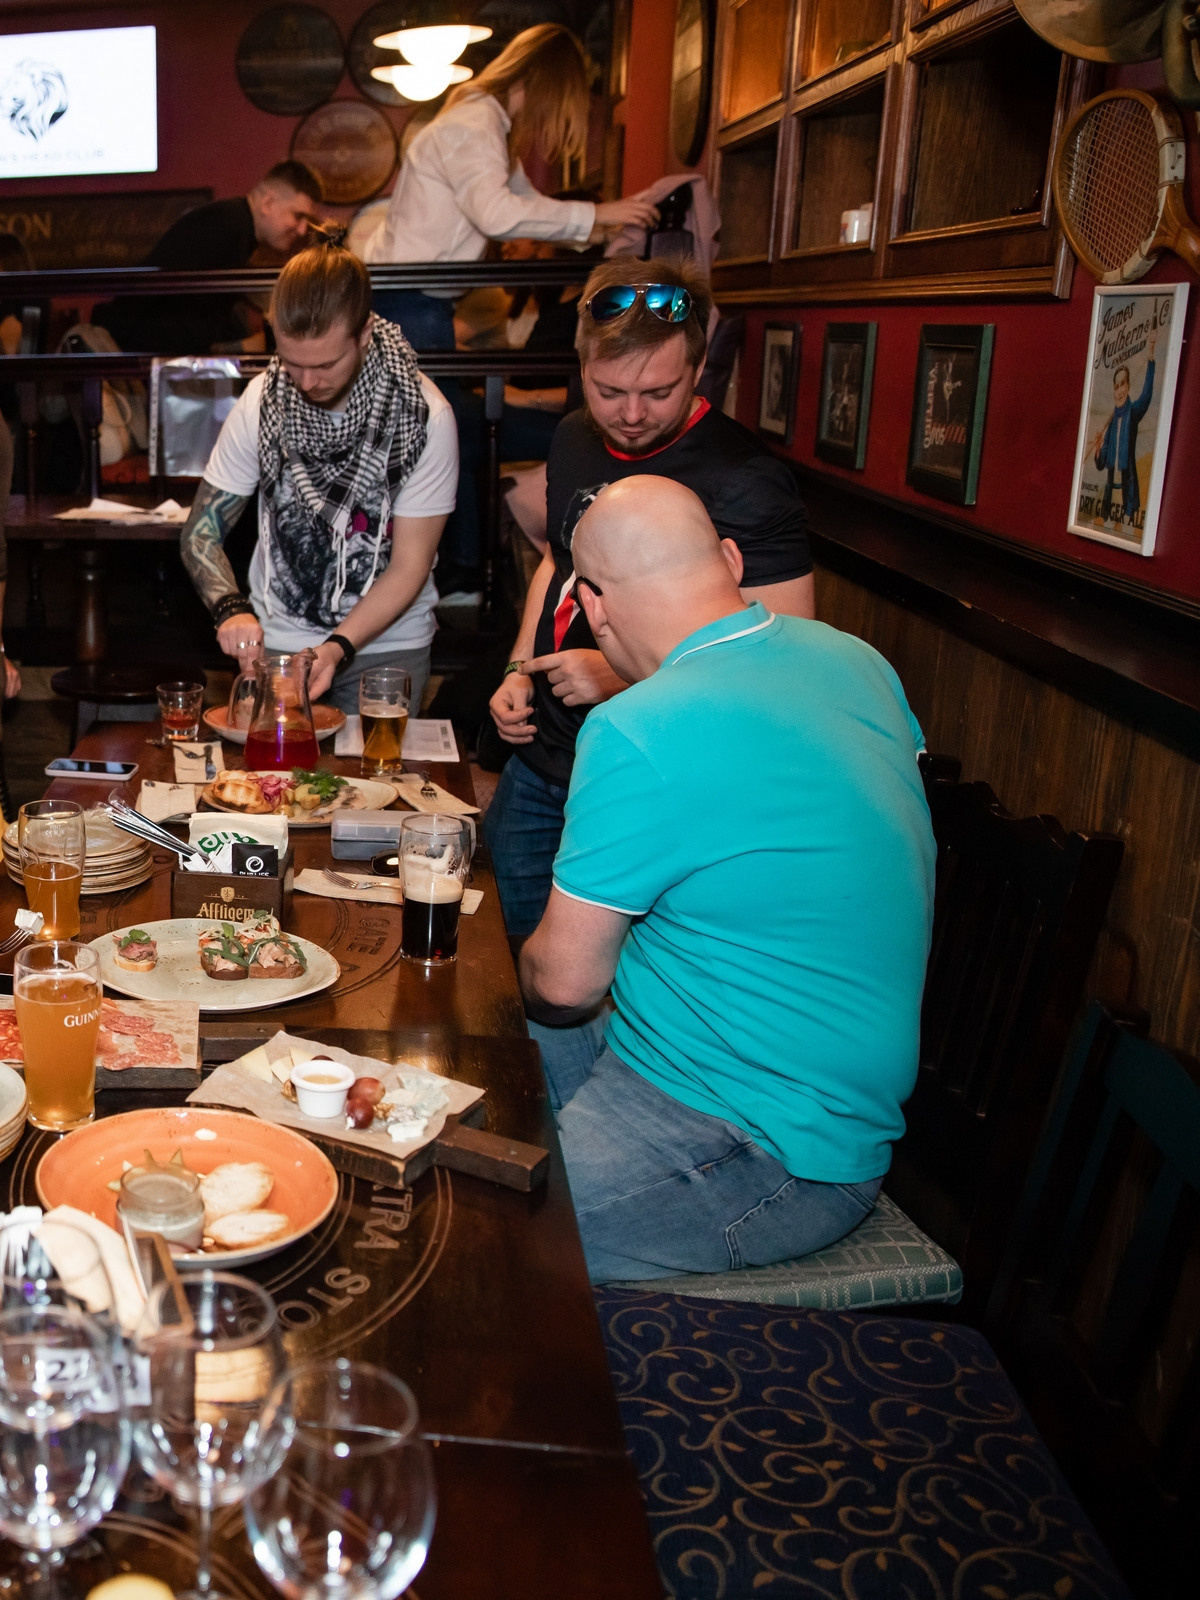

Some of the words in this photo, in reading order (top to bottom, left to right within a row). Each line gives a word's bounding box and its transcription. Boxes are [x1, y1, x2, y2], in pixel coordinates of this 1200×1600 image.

[1098, 302, 1135, 344] James
[1095, 325, 1144, 369] Mulhern
[1080, 495, 1095, 515] DRY
[196, 902, 255, 923] Affligem
